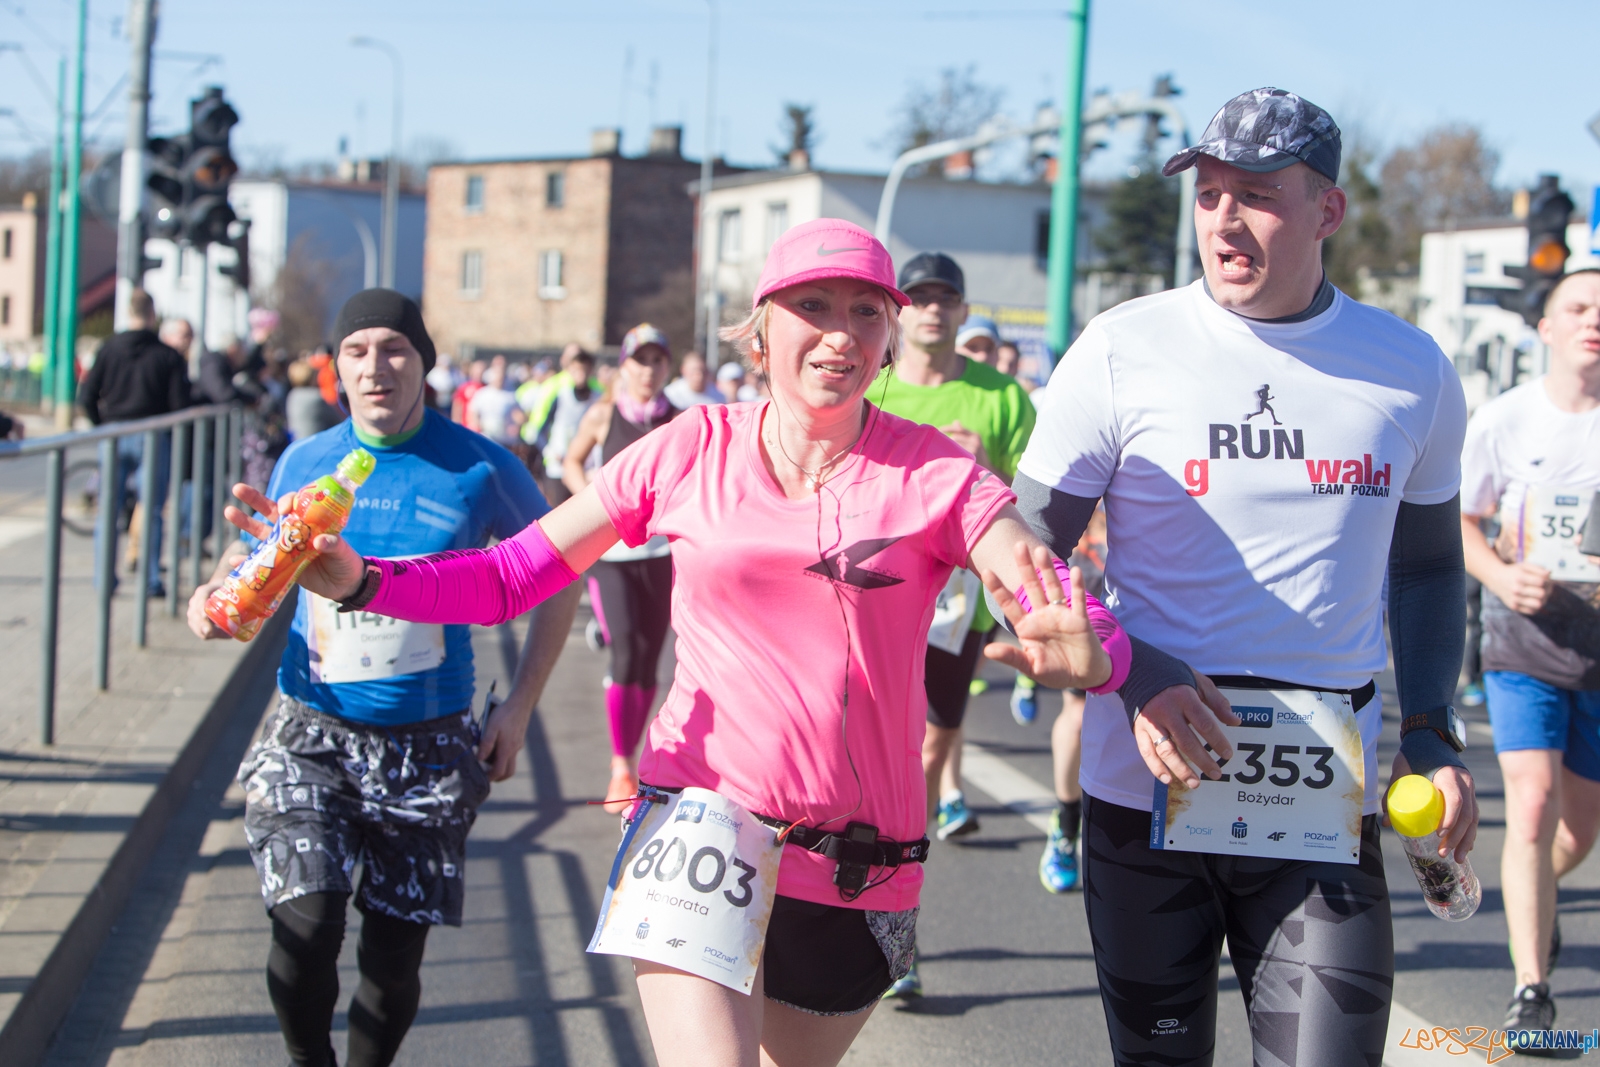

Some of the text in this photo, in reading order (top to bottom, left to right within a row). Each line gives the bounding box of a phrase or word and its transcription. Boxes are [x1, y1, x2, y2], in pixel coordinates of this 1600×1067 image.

[1311, 483, 1344, 495] TEAM
[1246, 712, 1269, 722] PKO
[1200, 742, 1334, 789] 2353
[1237, 790, 1296, 807] Bożydar
[1267, 831, 1287, 842] 4F
[632, 836, 757, 908] 8003
[646, 888, 709, 917] Honorata
[665, 937, 687, 948] 4F
[1151, 1026, 1188, 1035] Kalenji
